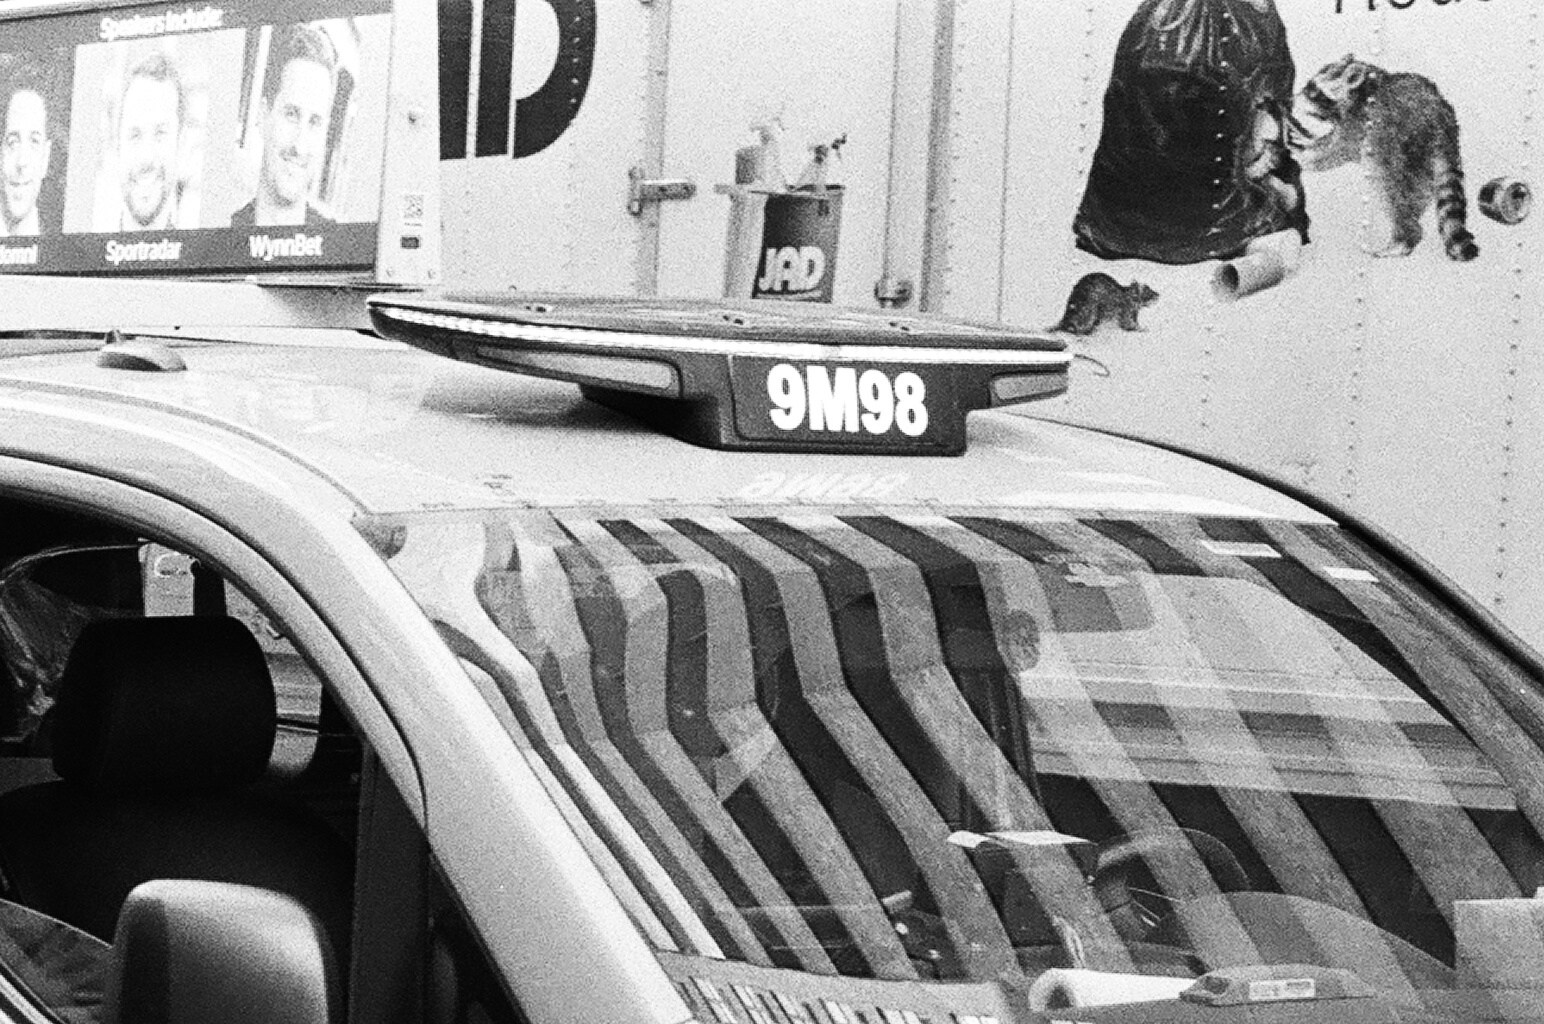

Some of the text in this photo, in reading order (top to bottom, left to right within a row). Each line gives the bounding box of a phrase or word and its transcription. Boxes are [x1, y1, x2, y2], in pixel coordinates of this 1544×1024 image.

[105, 240, 182, 265] Sportradar
[758, 246, 826, 291] JAD
[767, 363, 928, 436] 9M98
